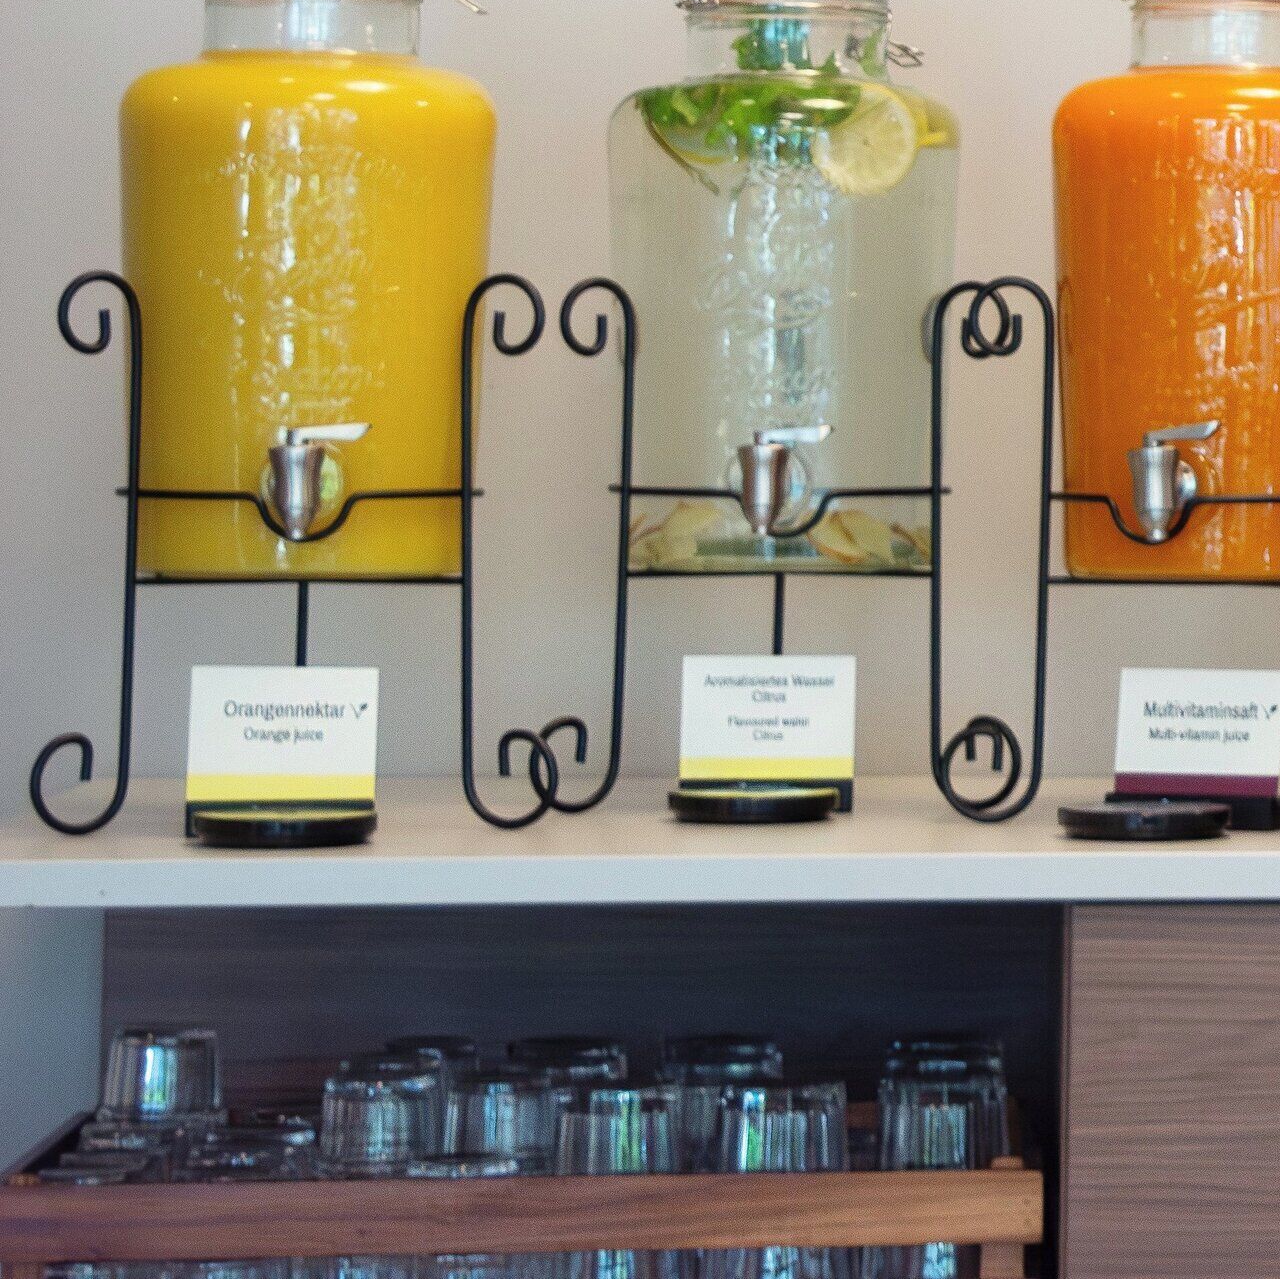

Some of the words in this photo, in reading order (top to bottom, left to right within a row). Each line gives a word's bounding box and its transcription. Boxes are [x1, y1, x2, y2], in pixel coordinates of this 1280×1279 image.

[791, 674, 836, 688] Wasser
[751, 691, 786, 704] Citrus
[223, 699, 345, 722] Orangennektar
[1143, 700, 1259, 720] Multivitaminsaft
[243, 726, 290, 743] Orange
[293, 727, 324, 744] juice
[752, 730, 784, 741] Citrus
[1222, 729, 1250, 744] juice
